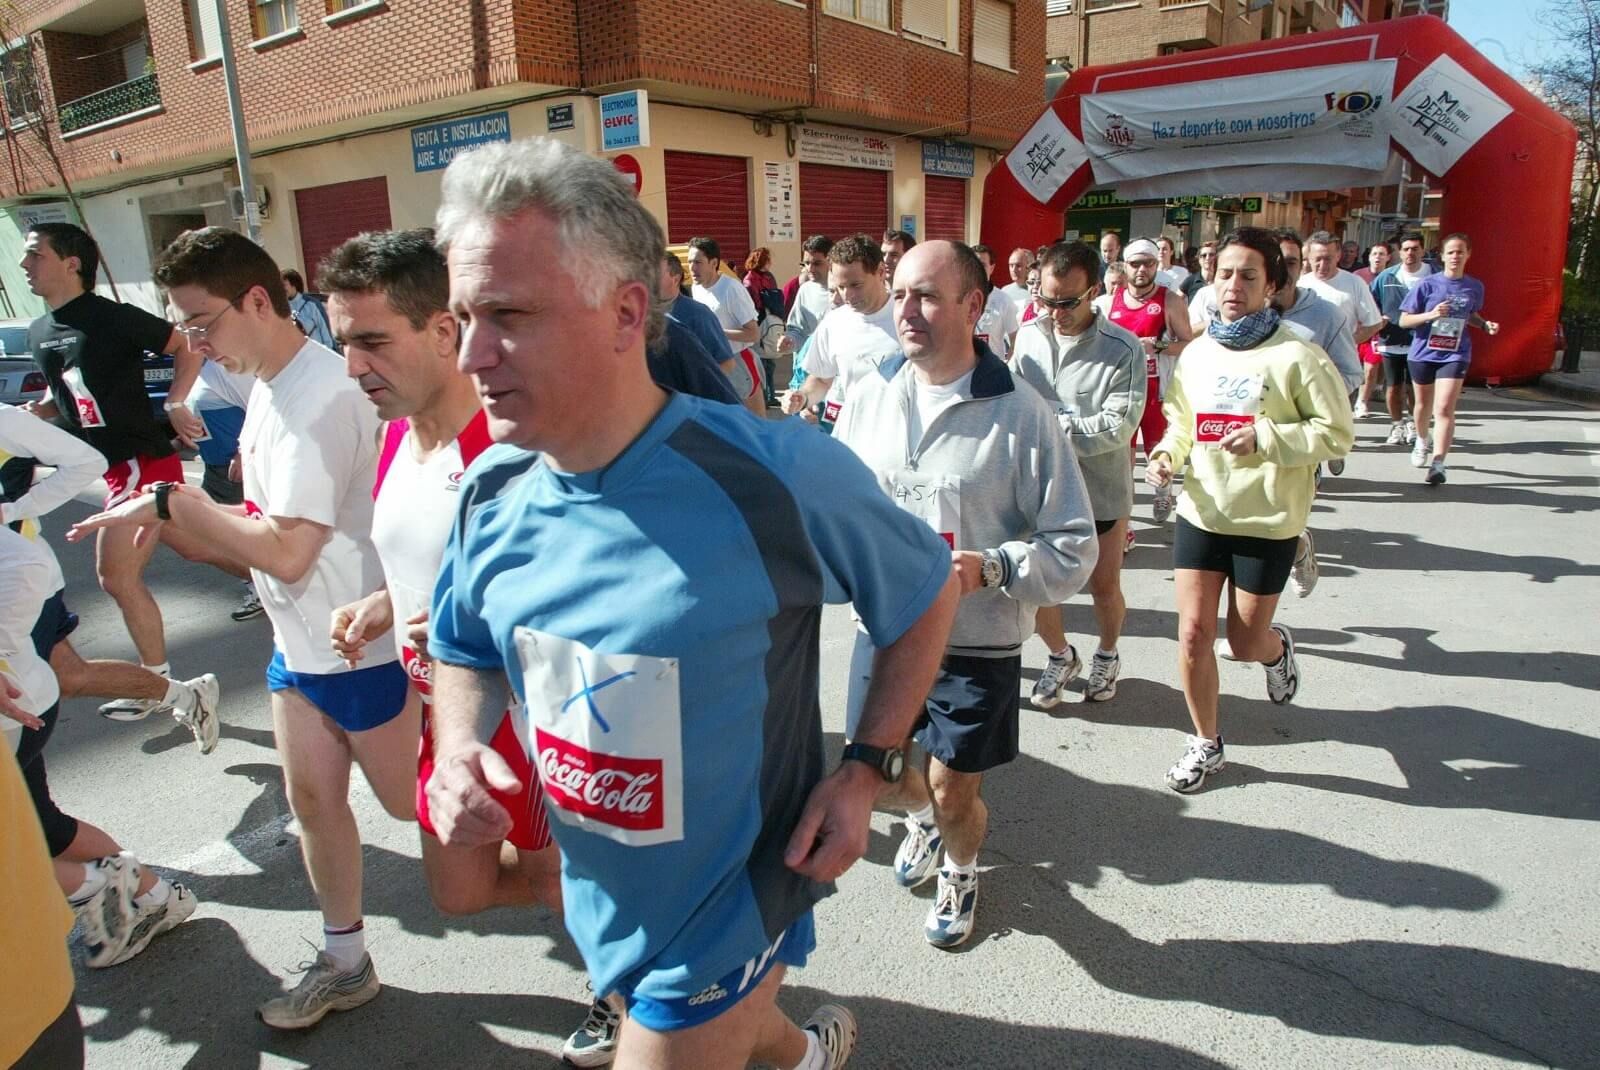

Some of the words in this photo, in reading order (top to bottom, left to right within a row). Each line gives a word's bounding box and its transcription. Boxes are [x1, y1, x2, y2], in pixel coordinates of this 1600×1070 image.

[413, 129, 440, 147] VENTA
[442, 128, 449, 143] E
[451, 117, 507, 141] INSTALACION
[1152, 122, 1176, 140] Haz
[1180, 119, 1226, 138] deporte
[1230, 114, 1253, 133] con
[1257, 111, 1316, 131] nosotros
[417, 151, 436, 168] AIRE
[896, 484, 938, 505] 451
[539, 747, 658, 813] Coca-Cola
[687, 988, 728, 1006] adidas
